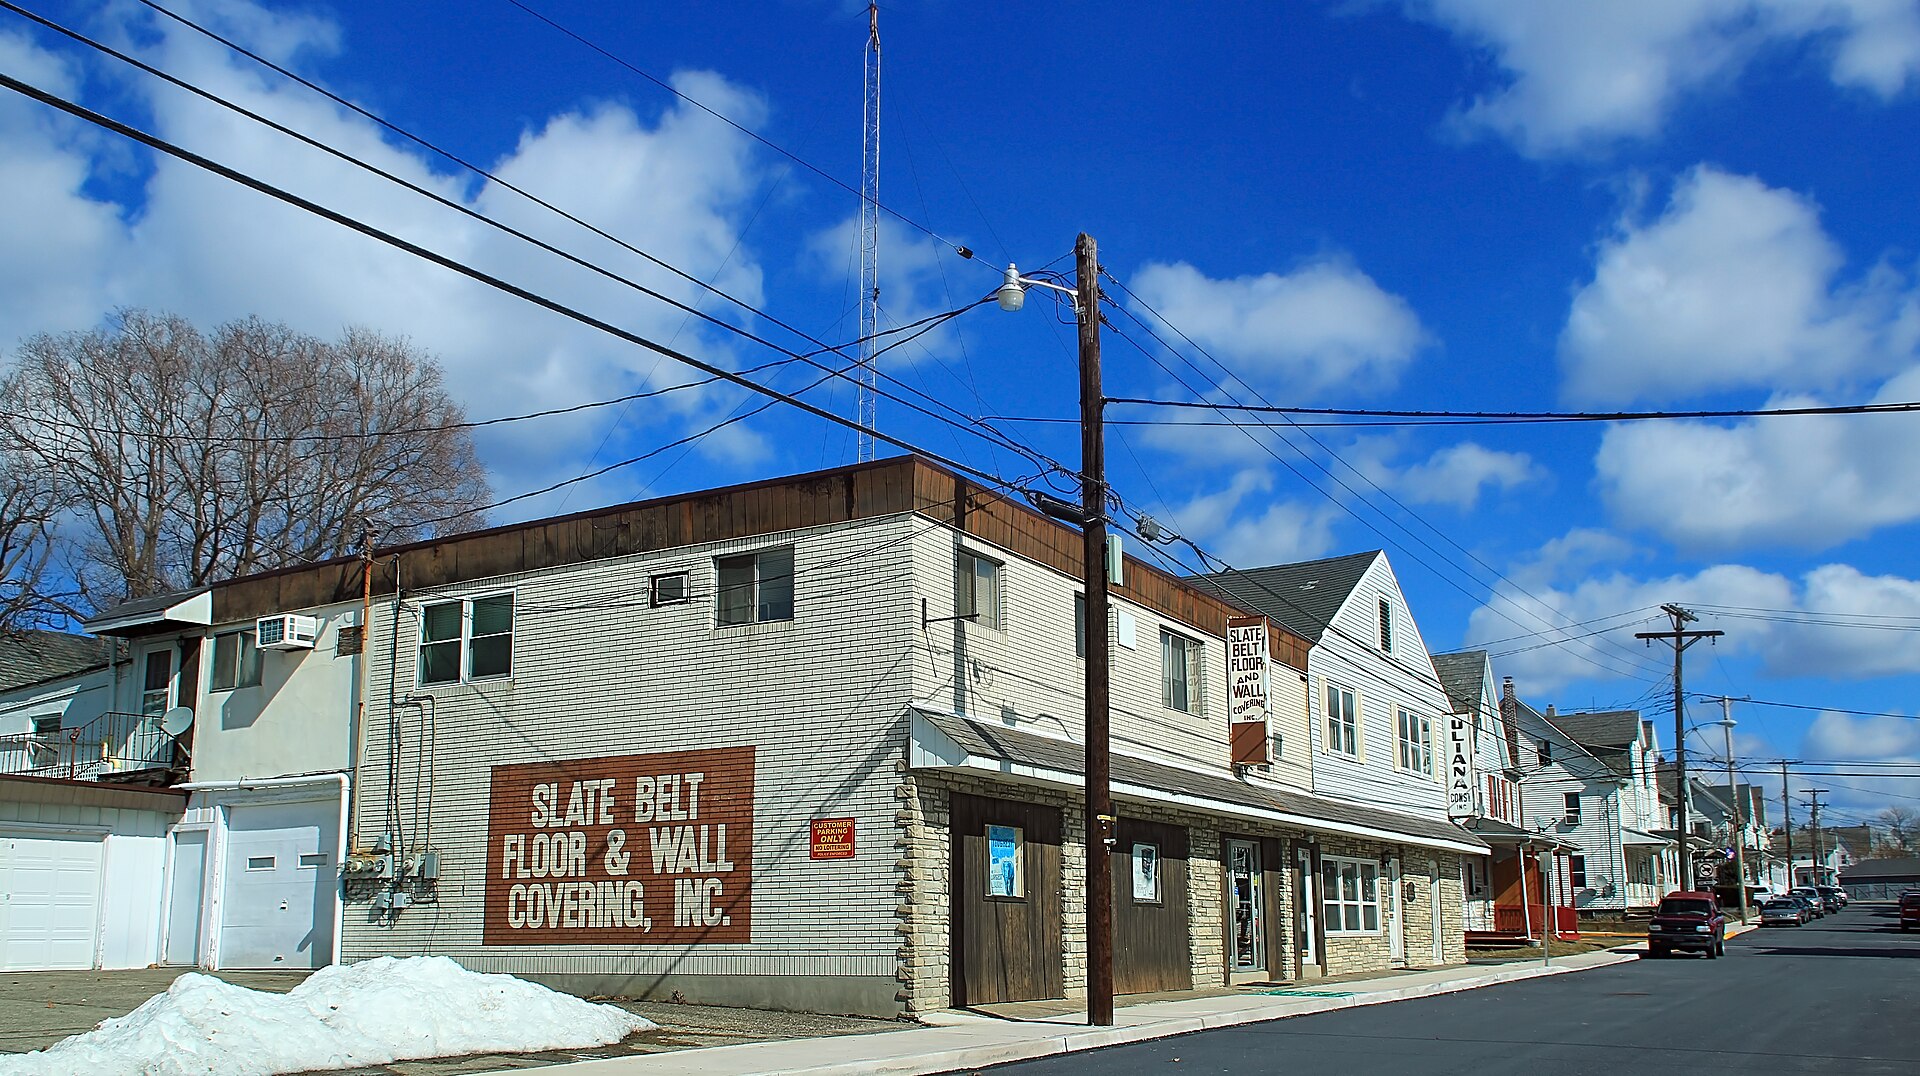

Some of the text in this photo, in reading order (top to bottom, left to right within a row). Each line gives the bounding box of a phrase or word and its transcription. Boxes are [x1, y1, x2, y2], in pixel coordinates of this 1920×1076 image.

[1230, 627, 1262, 643] SLATE
[1233, 642, 1260, 657] BELT
[1231, 656, 1263, 672] FLOOR
[1237, 672, 1259, 684] AND
[1232, 684, 1263, 698] WALL
[1233, 699, 1265, 714] COVERING
[531, 772, 705, 828] SLATE BELT
[813, 821, 852, 829] CUSTOMER
[820, 834, 844, 843] ONLY
[502, 824, 734, 879] FLOOR & WALL
[507, 878, 731, 933] COVERING, INC.
